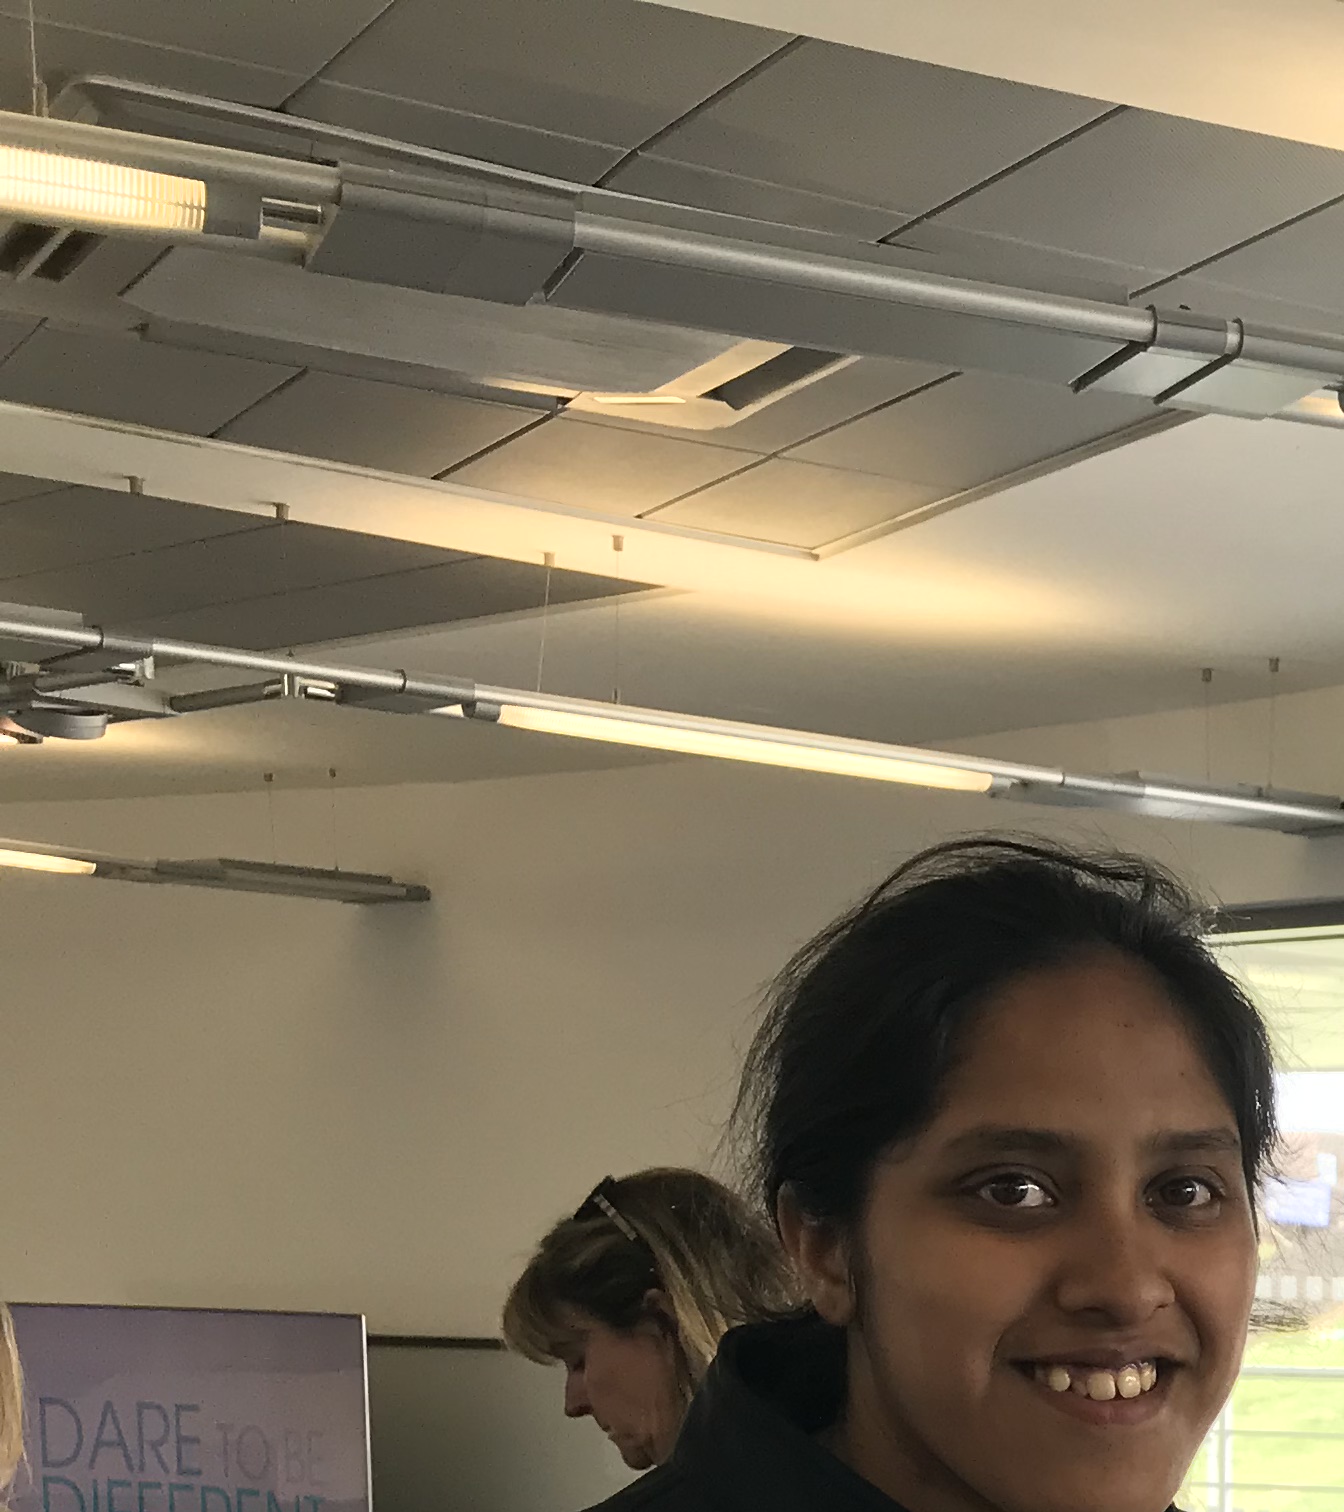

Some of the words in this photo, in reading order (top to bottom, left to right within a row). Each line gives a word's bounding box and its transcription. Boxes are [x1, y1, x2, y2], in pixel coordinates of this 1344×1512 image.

[39, 1397, 202, 1476] DARE
[216, 1422, 271, 1479] TO
[284, 1428, 325, 1485] BE
